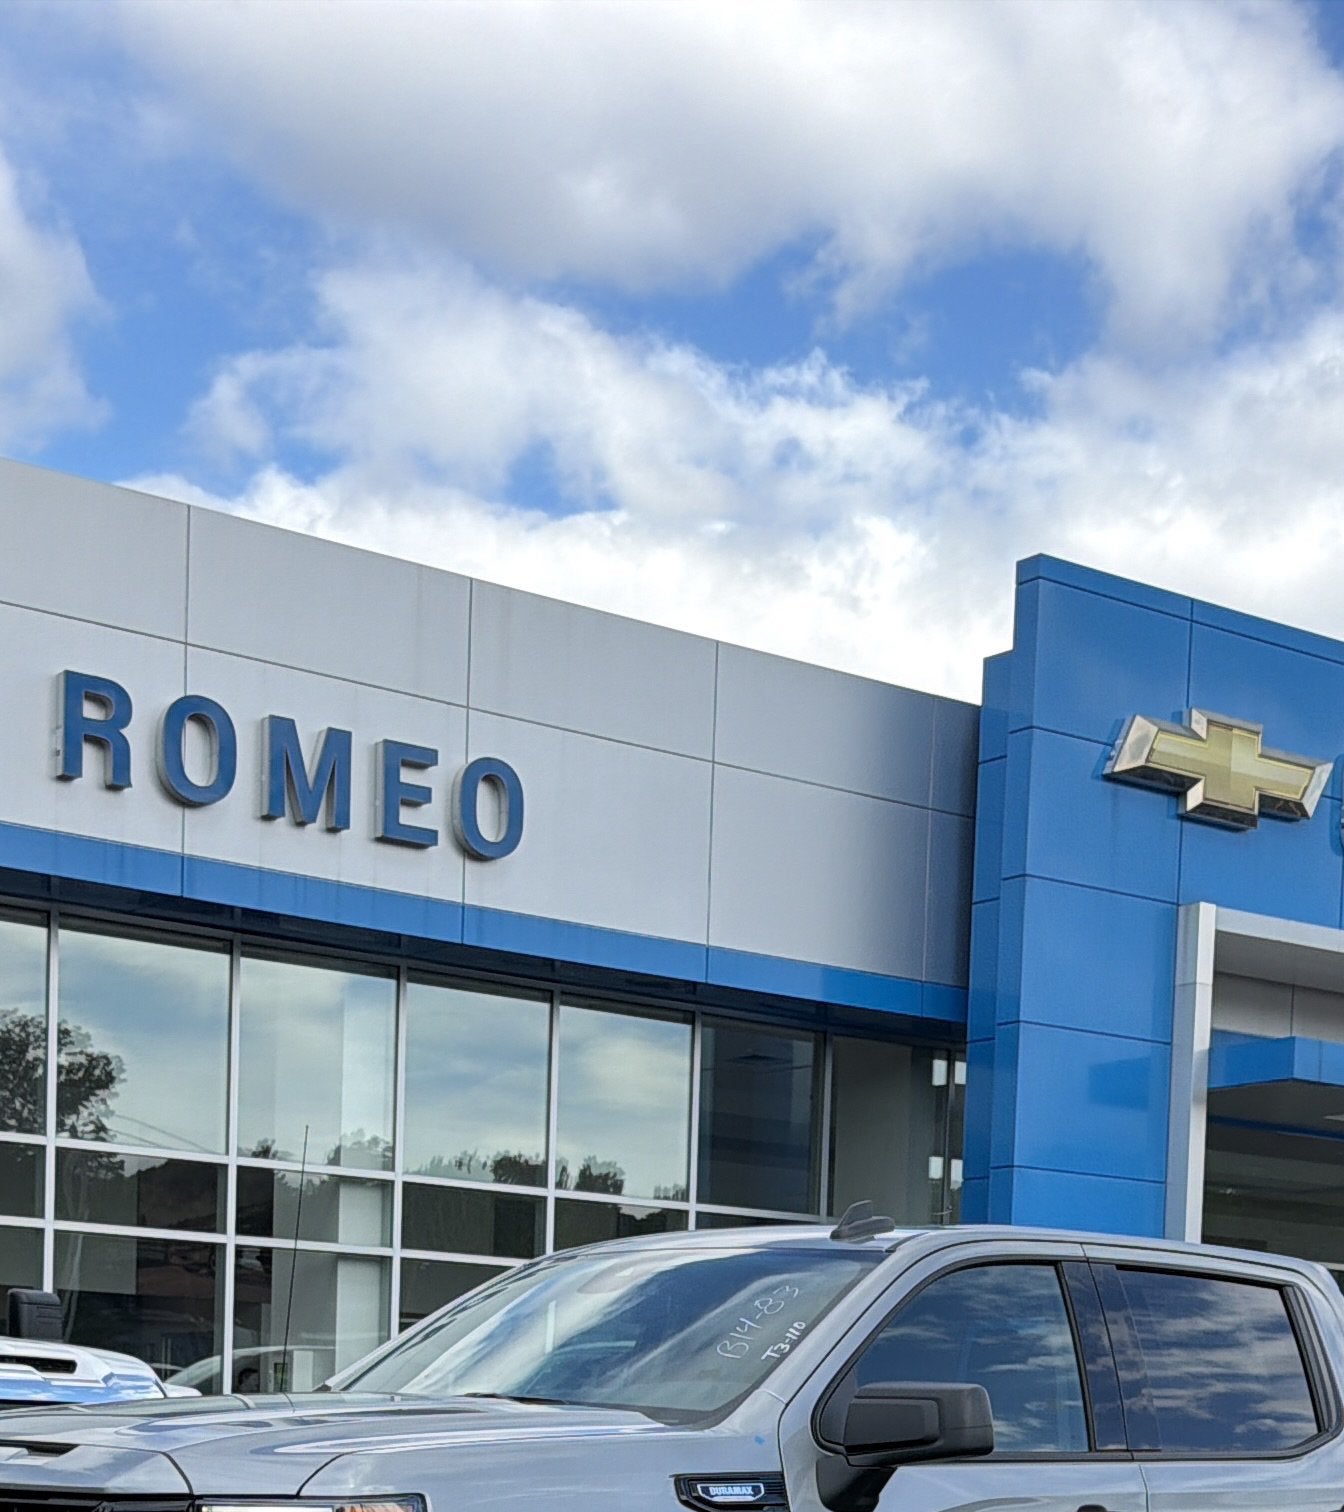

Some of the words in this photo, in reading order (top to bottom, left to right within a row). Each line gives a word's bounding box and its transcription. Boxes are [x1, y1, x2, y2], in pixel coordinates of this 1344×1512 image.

[56, 669, 524, 861] ROMEO
[716, 1285, 799, 1359] B14-83
[760, 1321, 807, 1360] T3-110
[709, 1486, 754, 1496] DURAMAX
